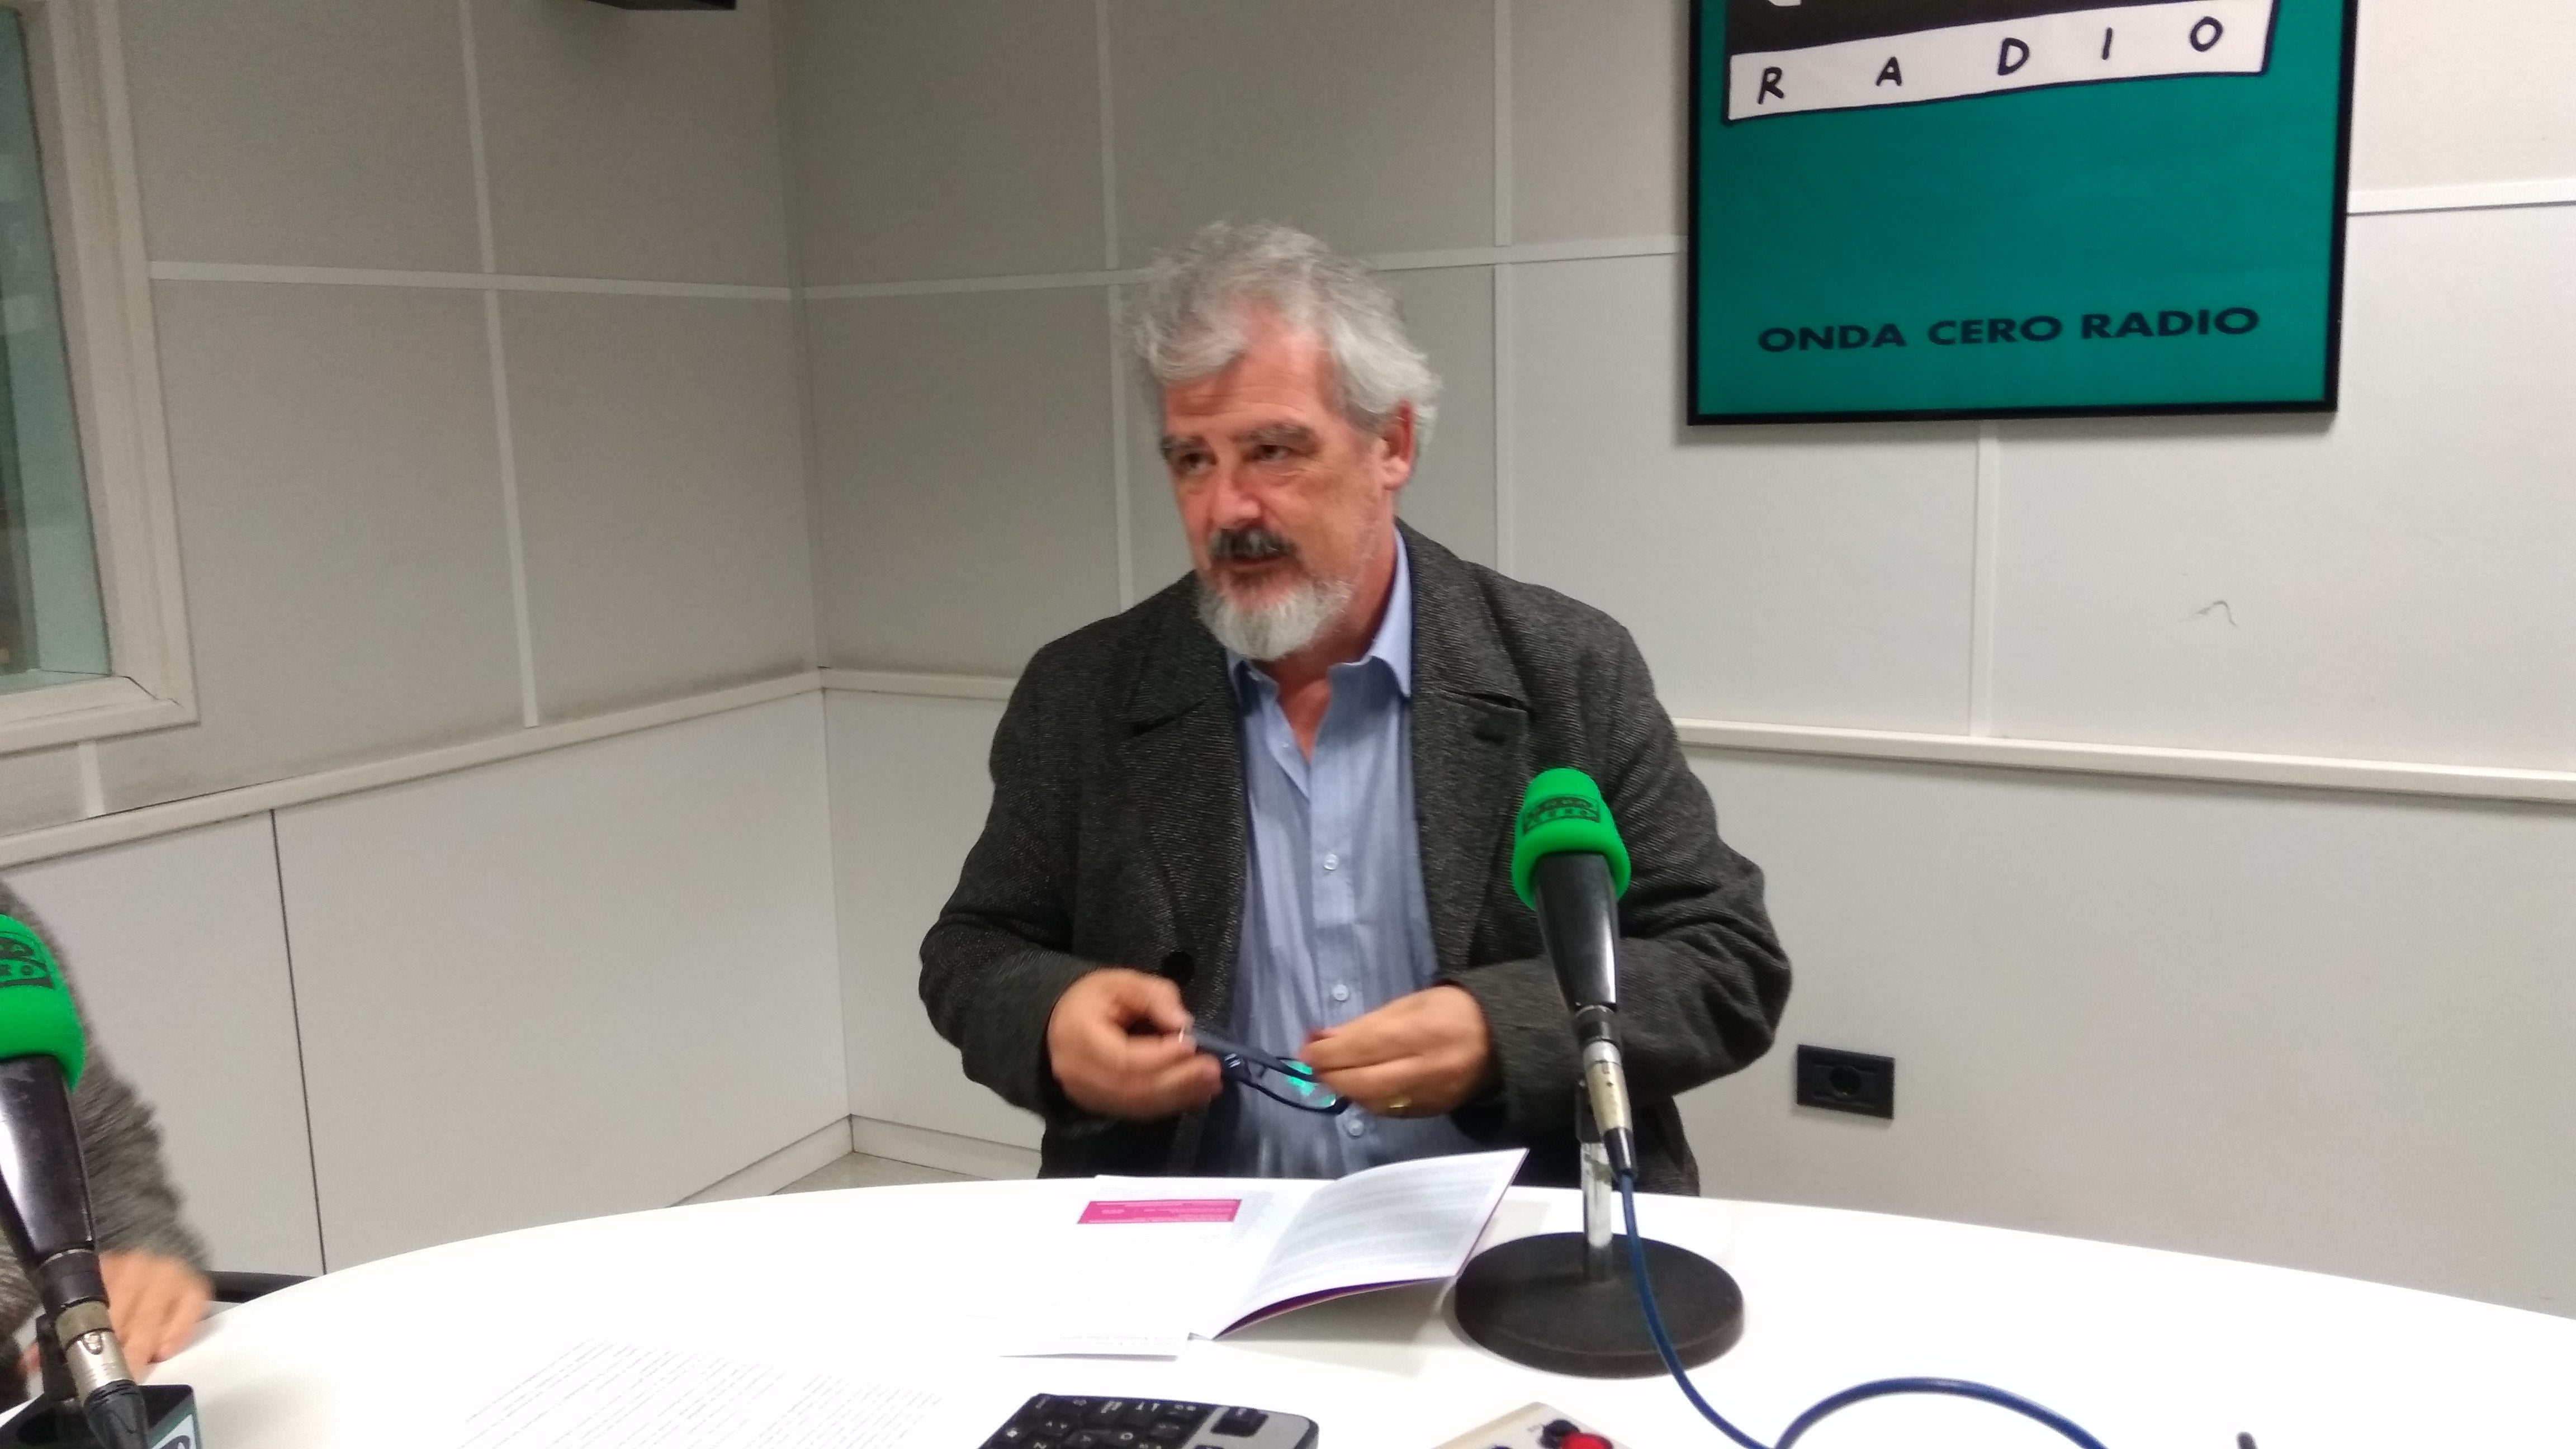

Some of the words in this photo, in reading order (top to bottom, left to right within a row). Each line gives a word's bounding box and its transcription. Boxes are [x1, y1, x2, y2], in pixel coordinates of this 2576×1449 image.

[1756, 16, 2223, 105] RADIO
[1757, 323, 1906, 353] ONDA
[1927, 315, 2062, 345] CERO
[2081, 307, 2258, 339] RADIO
